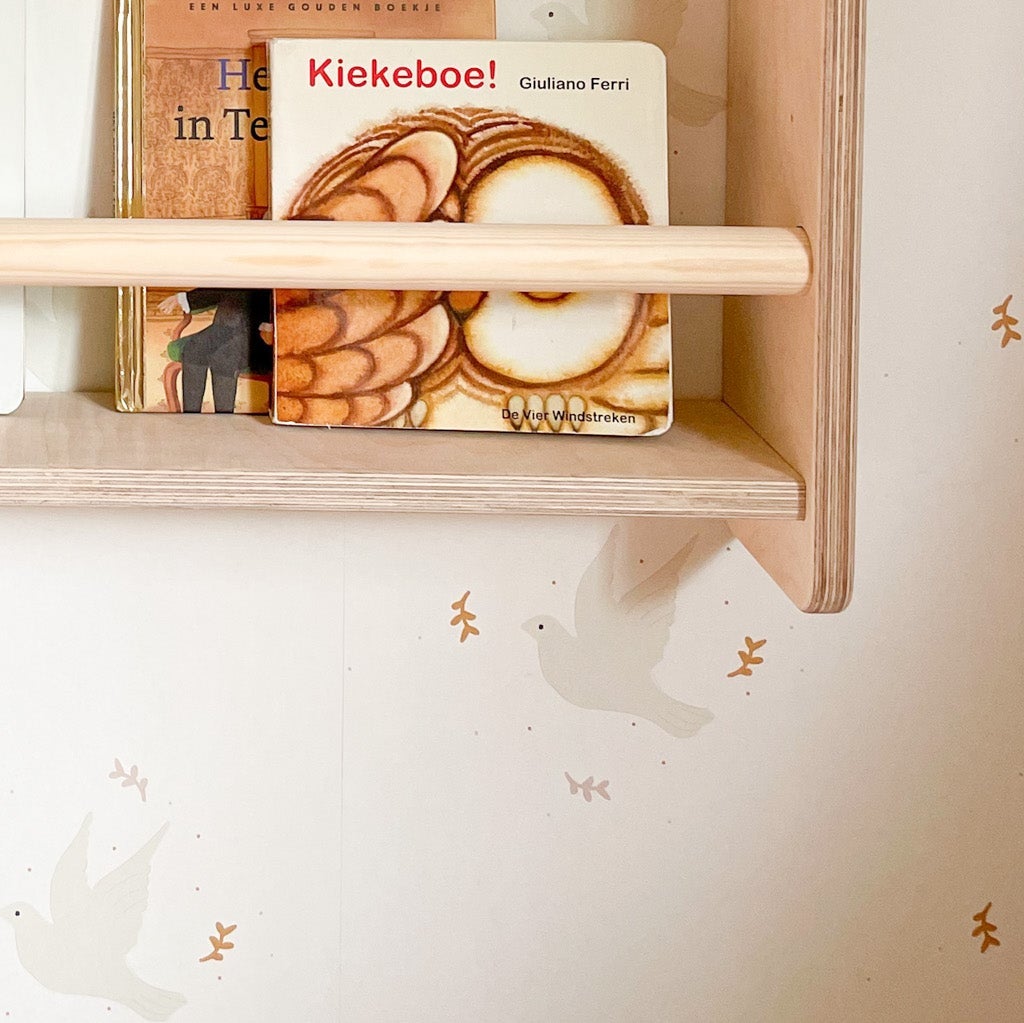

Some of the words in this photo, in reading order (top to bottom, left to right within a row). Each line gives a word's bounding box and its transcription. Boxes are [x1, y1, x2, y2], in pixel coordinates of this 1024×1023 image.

[189, 2, 220, 11] EEN
[233, 2, 275, 11] LUXE
[288, 3, 361, 12] GOUDEN
[374, 3, 442, 12] BOEKJE
[309, 58, 497, 89] Kiekeboe!
[519, 76, 586, 91] Giuliano
[590, 77, 630, 91] Ferri
[174, 105, 215, 140] in
[502, 409, 519, 420] De
[522, 409, 550, 421] Vier
[552, 410, 636, 424] Windstreken
